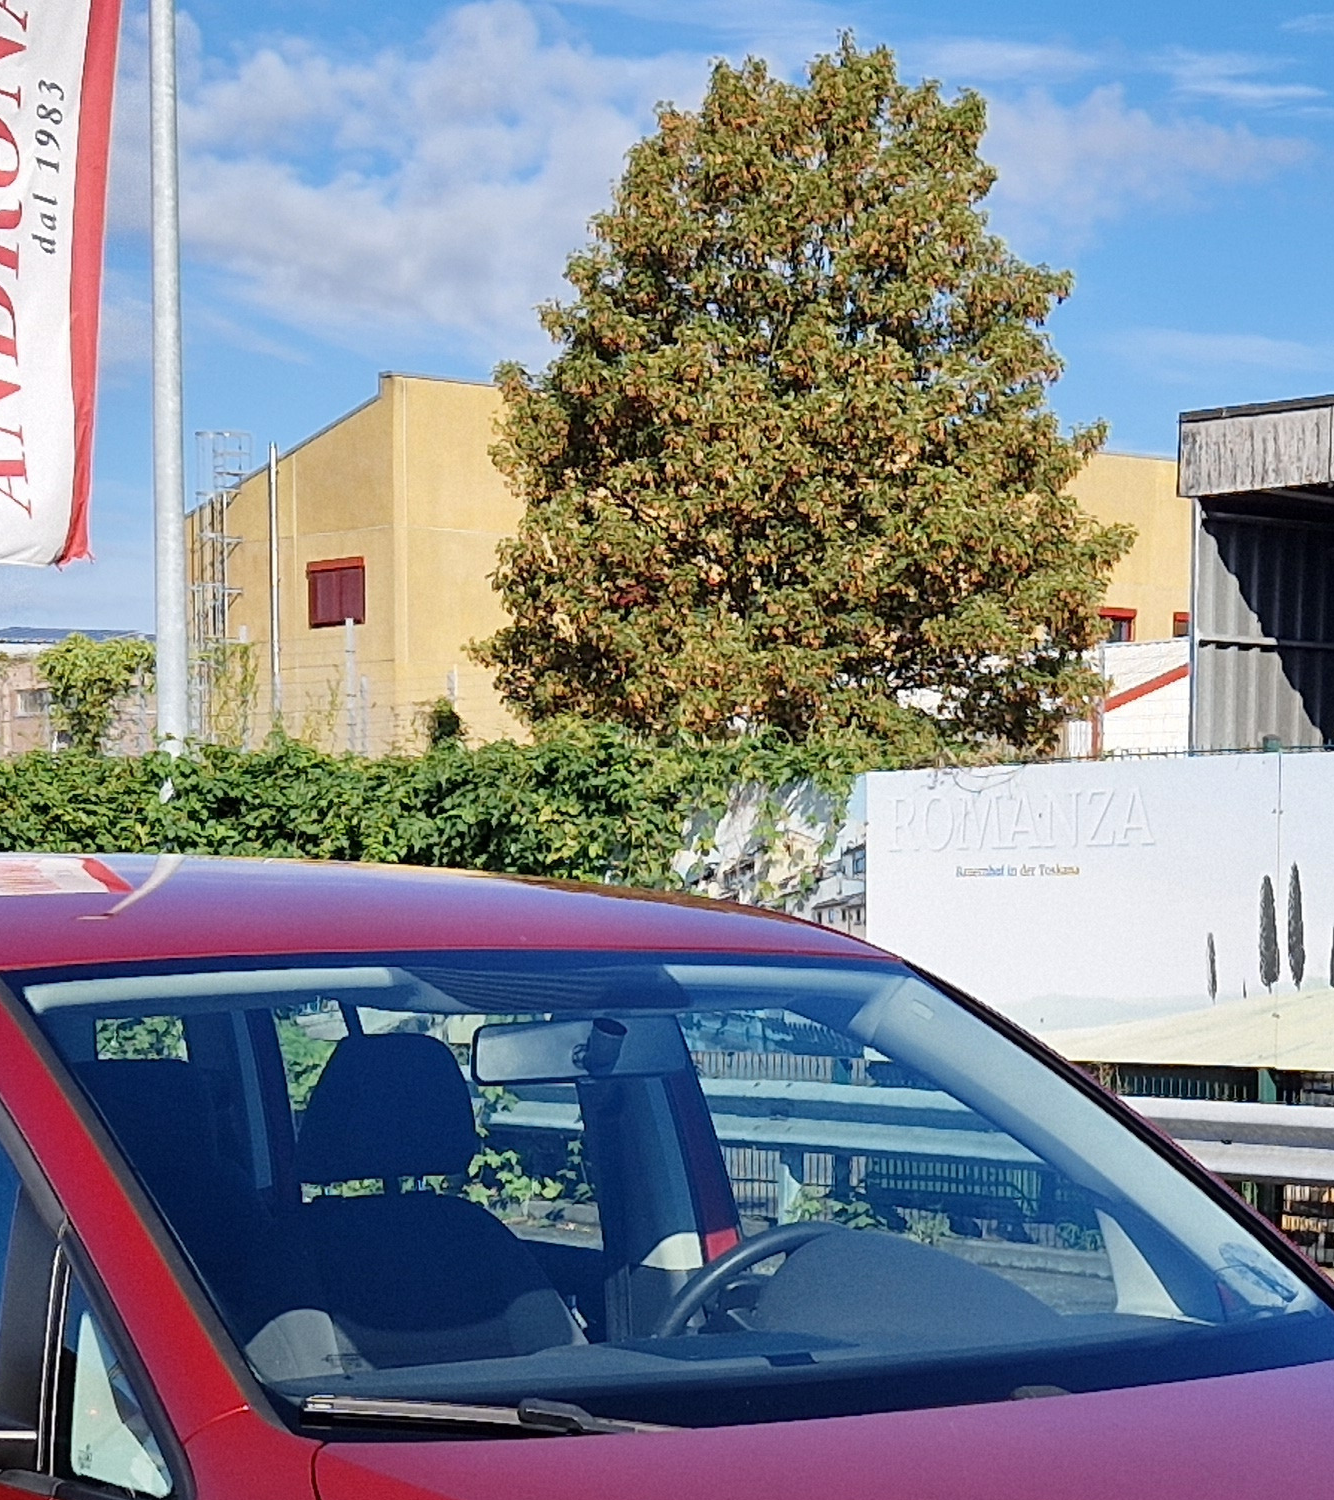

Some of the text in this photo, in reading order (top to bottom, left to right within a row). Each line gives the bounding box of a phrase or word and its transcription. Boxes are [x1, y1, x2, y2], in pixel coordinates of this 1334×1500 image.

[32, 79, 65, 255] dal 1983
[889, 784, 1156, 853] ROMANZA
[1020, 863, 1036, 876] der
